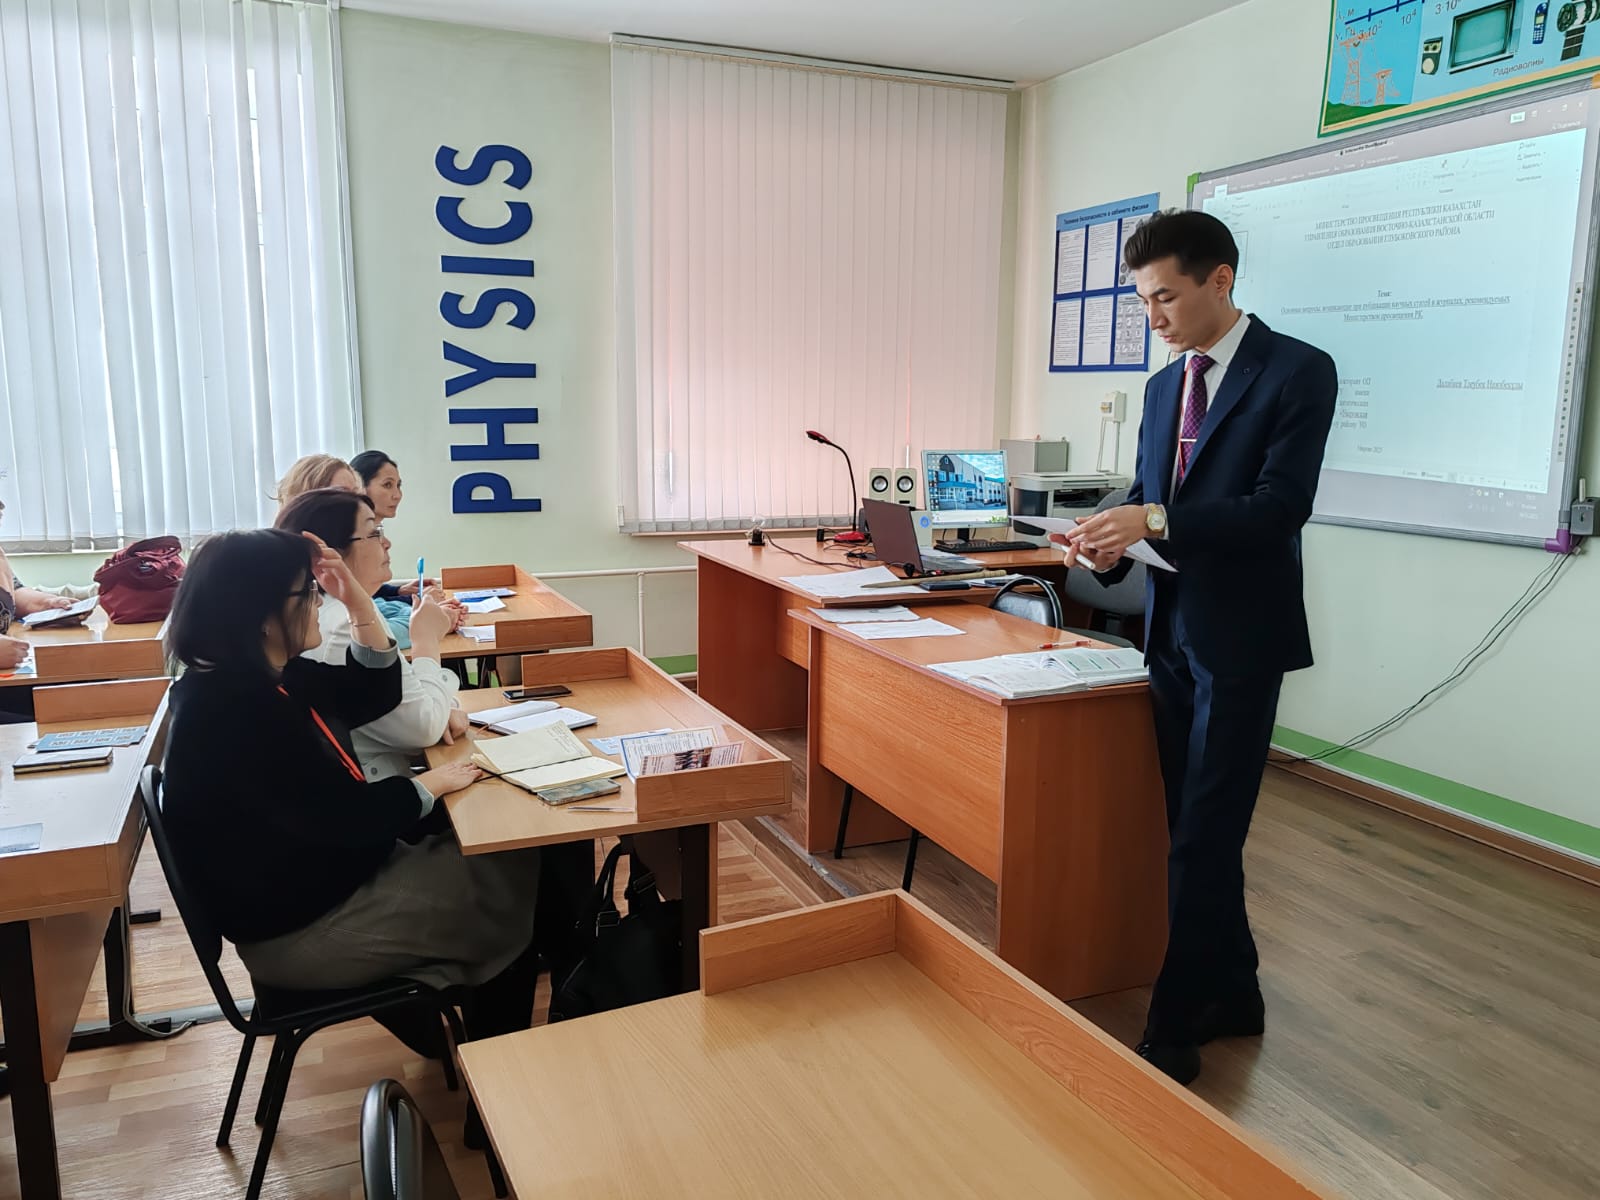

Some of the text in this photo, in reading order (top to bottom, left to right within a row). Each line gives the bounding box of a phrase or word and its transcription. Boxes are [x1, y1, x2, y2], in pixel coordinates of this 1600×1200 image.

[1493, 58, 1544, 76] Радиоволны
[1402, 205, 1442, 218] РЕСПУБЛИКИ
[1443, 199, 1482, 212] КАЗАХСТАН
[1463, 209, 1495, 221] ОБЛАСТИ
[1435, 226, 1461, 237] РАЙОНА
[435, 144, 541, 513] PHYSICS
